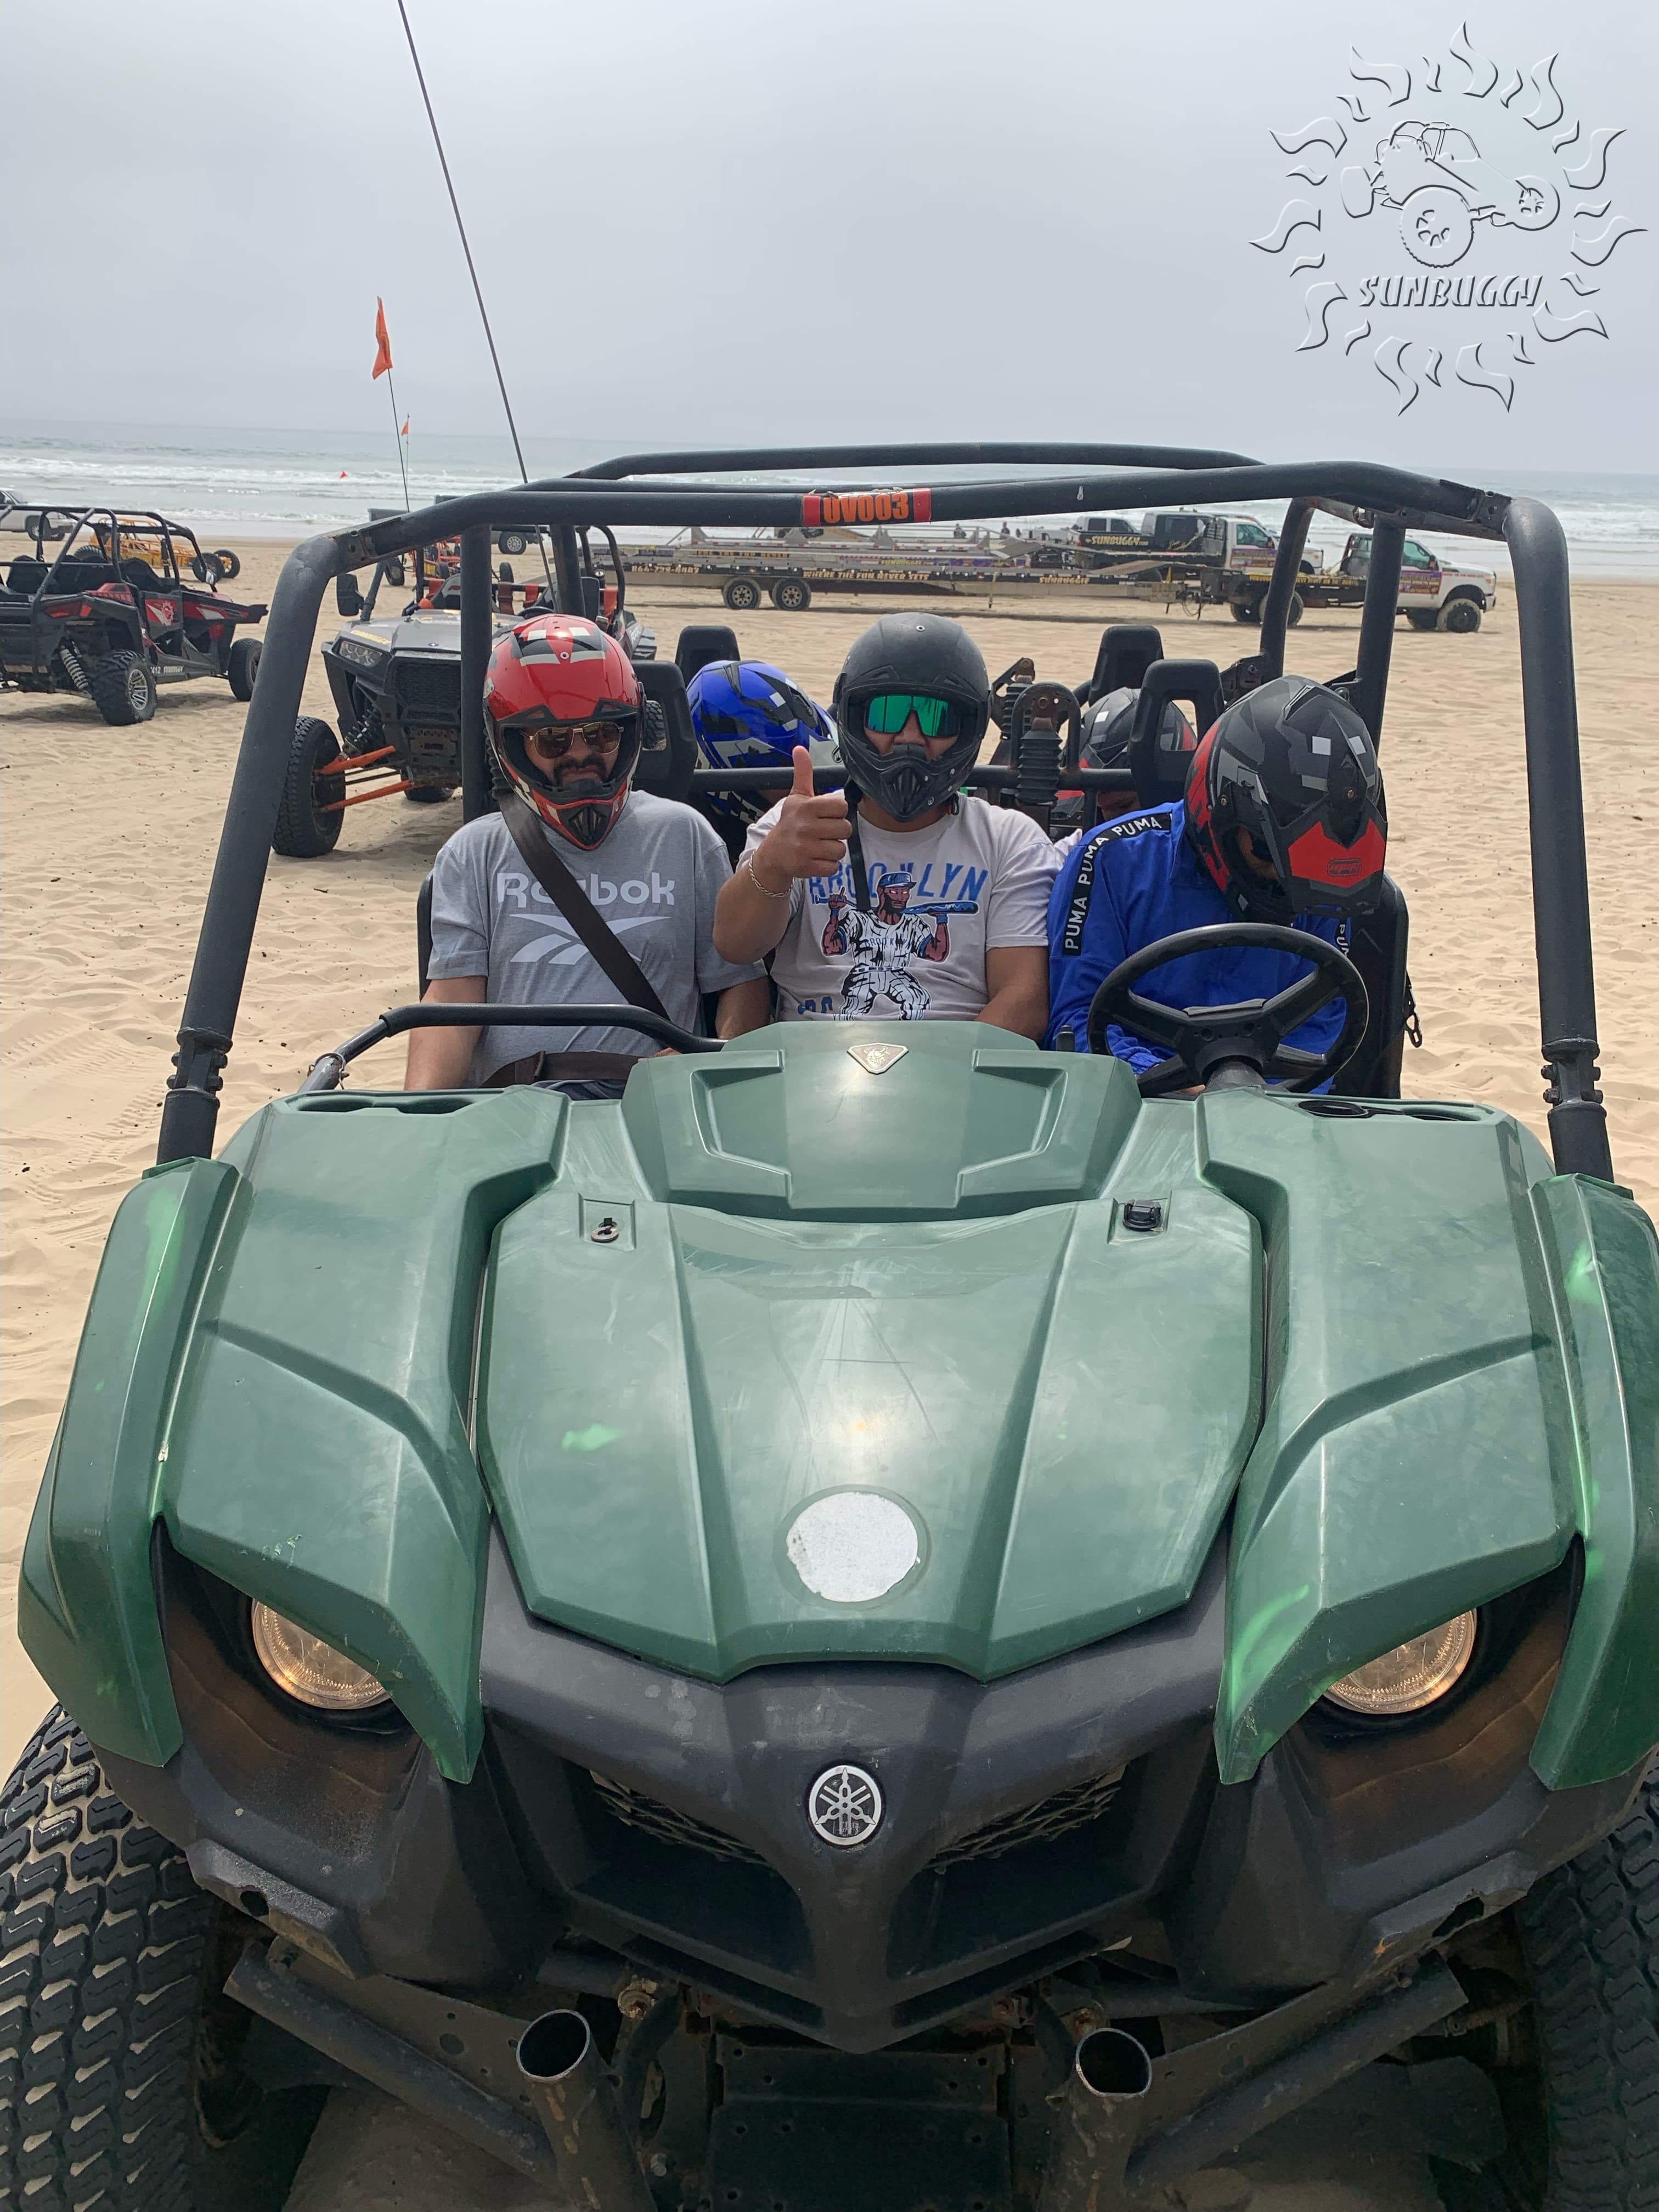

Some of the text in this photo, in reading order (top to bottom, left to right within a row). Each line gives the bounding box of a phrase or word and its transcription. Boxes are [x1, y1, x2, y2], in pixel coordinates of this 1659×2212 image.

[823, 492, 909, 523] UV003
[1065, 816, 1163, 950] PUMA PUMA PUMA
